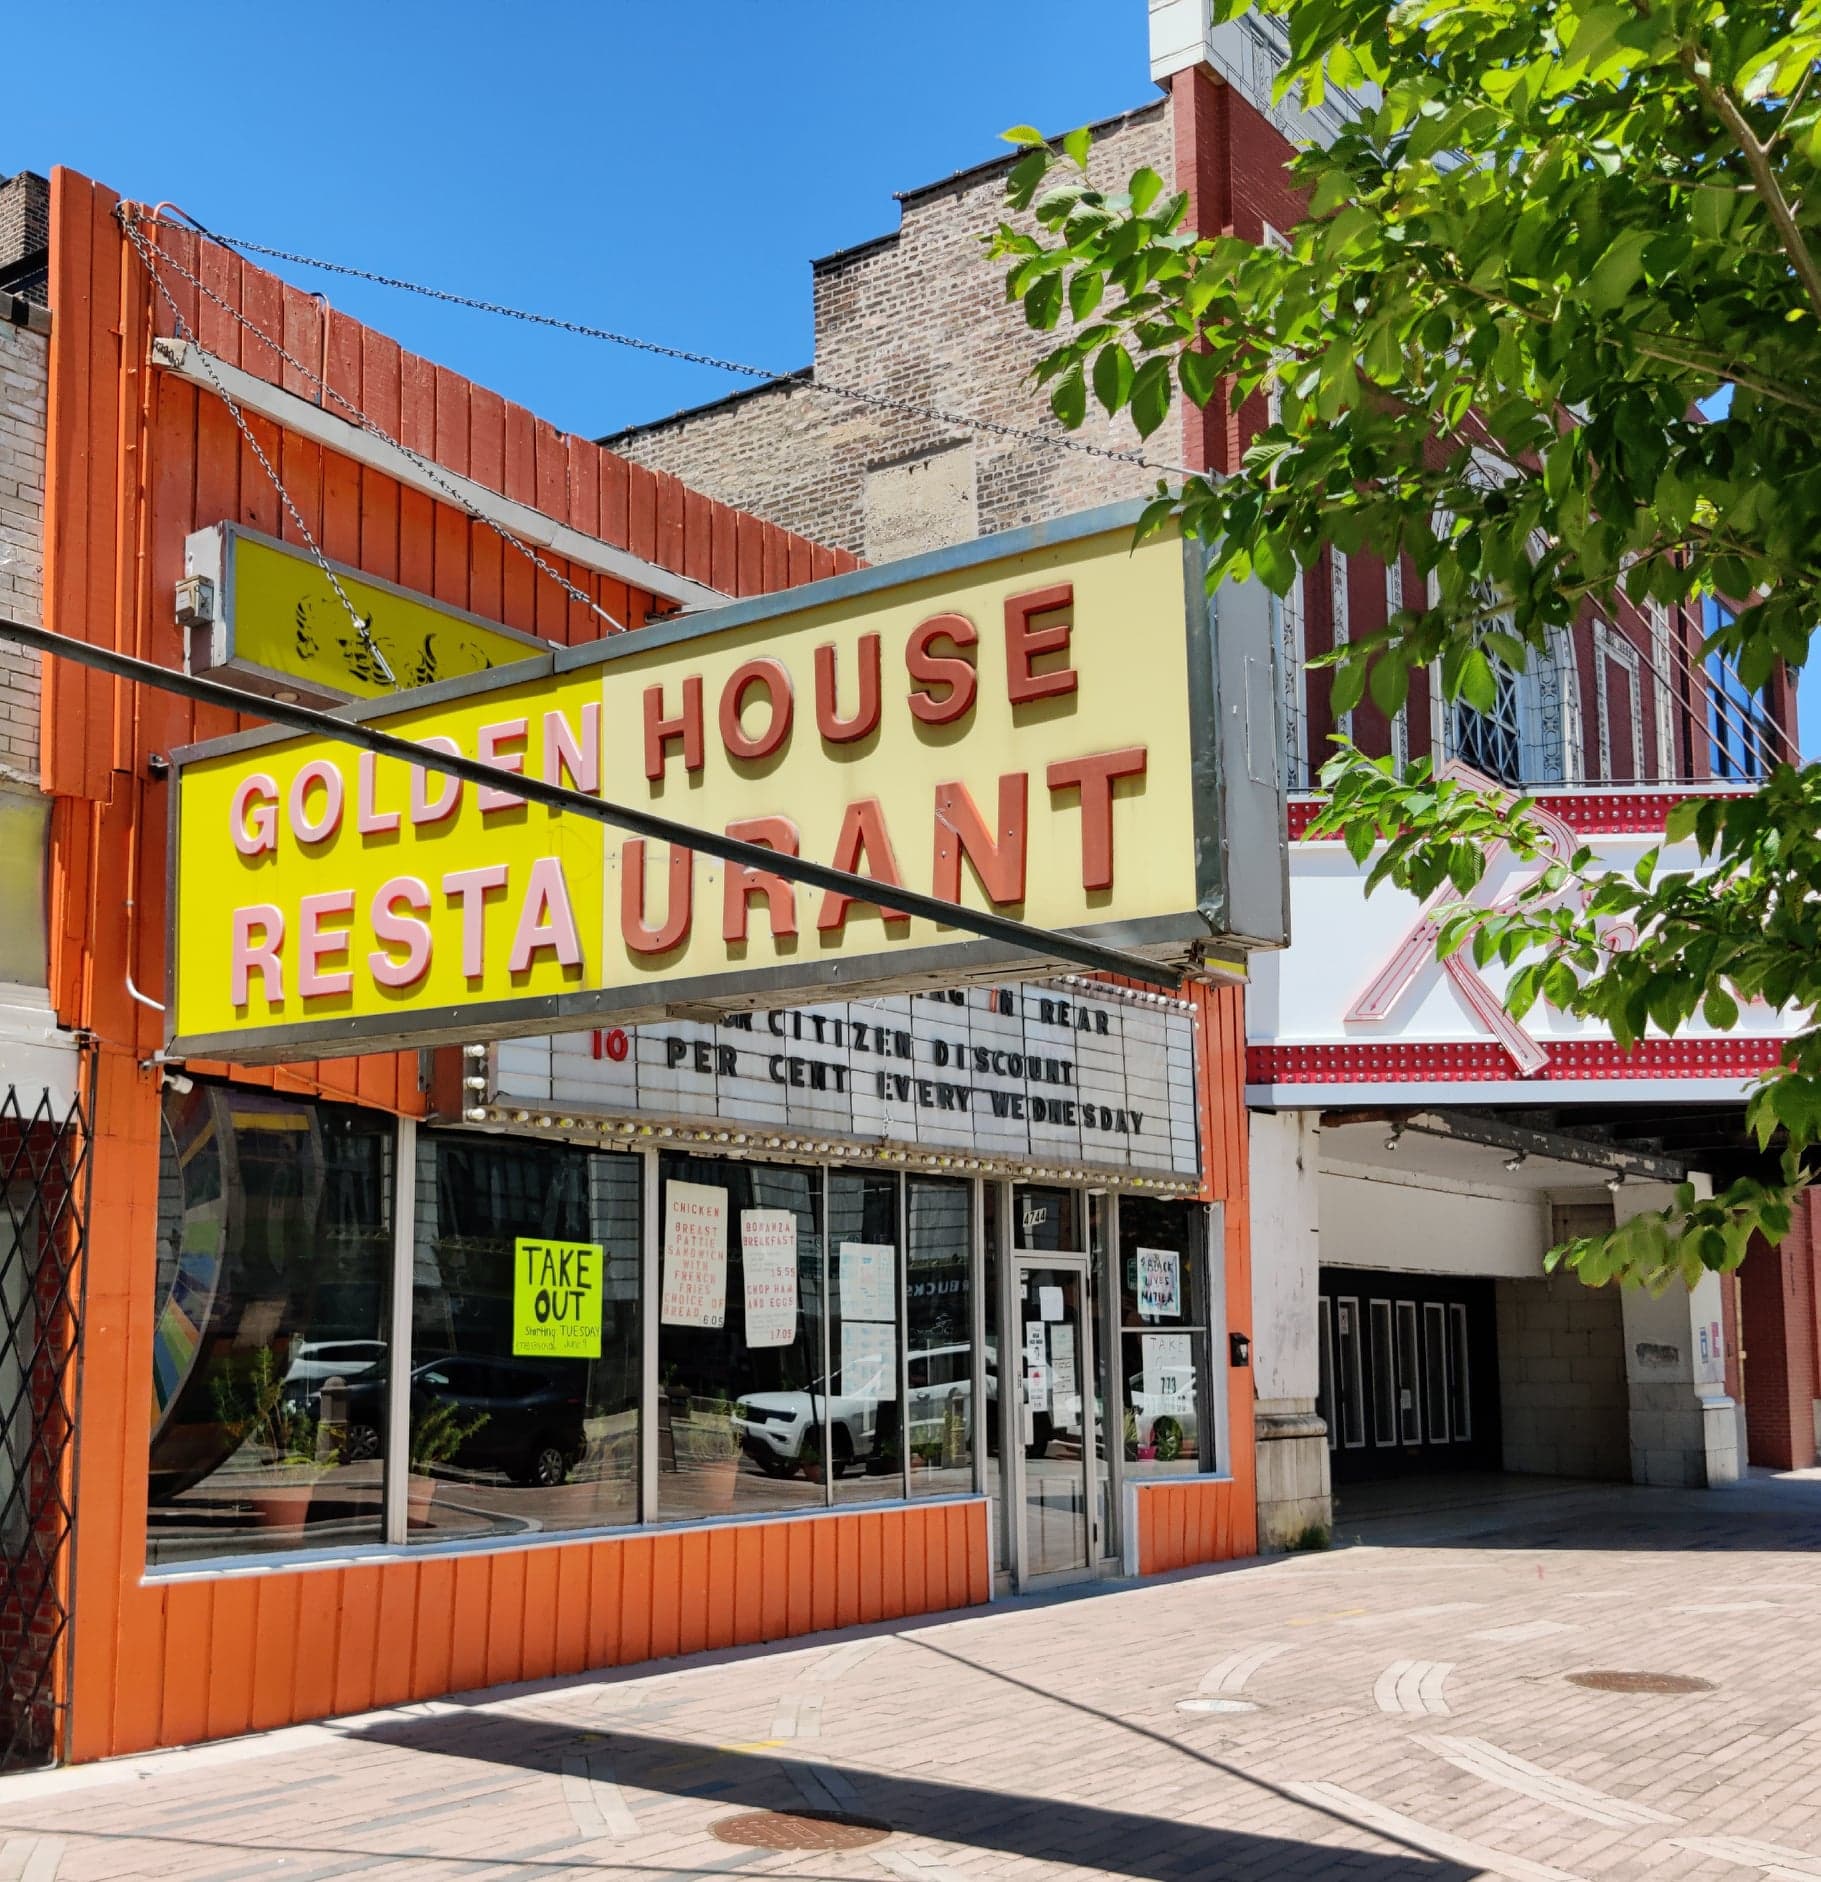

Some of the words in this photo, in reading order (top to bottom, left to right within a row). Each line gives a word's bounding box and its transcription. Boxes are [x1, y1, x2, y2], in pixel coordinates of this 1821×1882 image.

[229, 703, 600, 856] GOLDEN
[643, 581, 1078, 780] HOUSE
[231, 746, 1147, 1007] RESTAURANT
[989, 986, 1014, 1017] IN
[1040, 998, 1109, 1036] REAR
[768, 1009, 911, 1060] CITIZEN
[935, 1039, 1073, 1086] DISCOUNT
[667, 1037, 737, 1077] PER
[769, 1054, 848, 1094] CENT
[877, 1071, 973, 1113] EVERY
[989, 1090, 1144, 1135] WEDNESDAY
[673, 1202, 720, 1217] CHICKEN
[1023, 1209, 1046, 1225] 4744
[675, 1222, 718, 1237] BREAST
[746, 1222, 791, 1232] BONANZA
[743, 1235, 794, 1247] BREAKFAST
[667, 1246, 724, 1261] SANDWICH
[522, 1246, 593, 1290] TAKE
[682, 1260, 709, 1272] WITH
[674, 1270, 717, 1285] FRENCH
[679, 1283, 711, 1296] FRIES
[534, 1289, 586, 1324] OUT
[560, 1324, 600, 1337] TUESDAY
